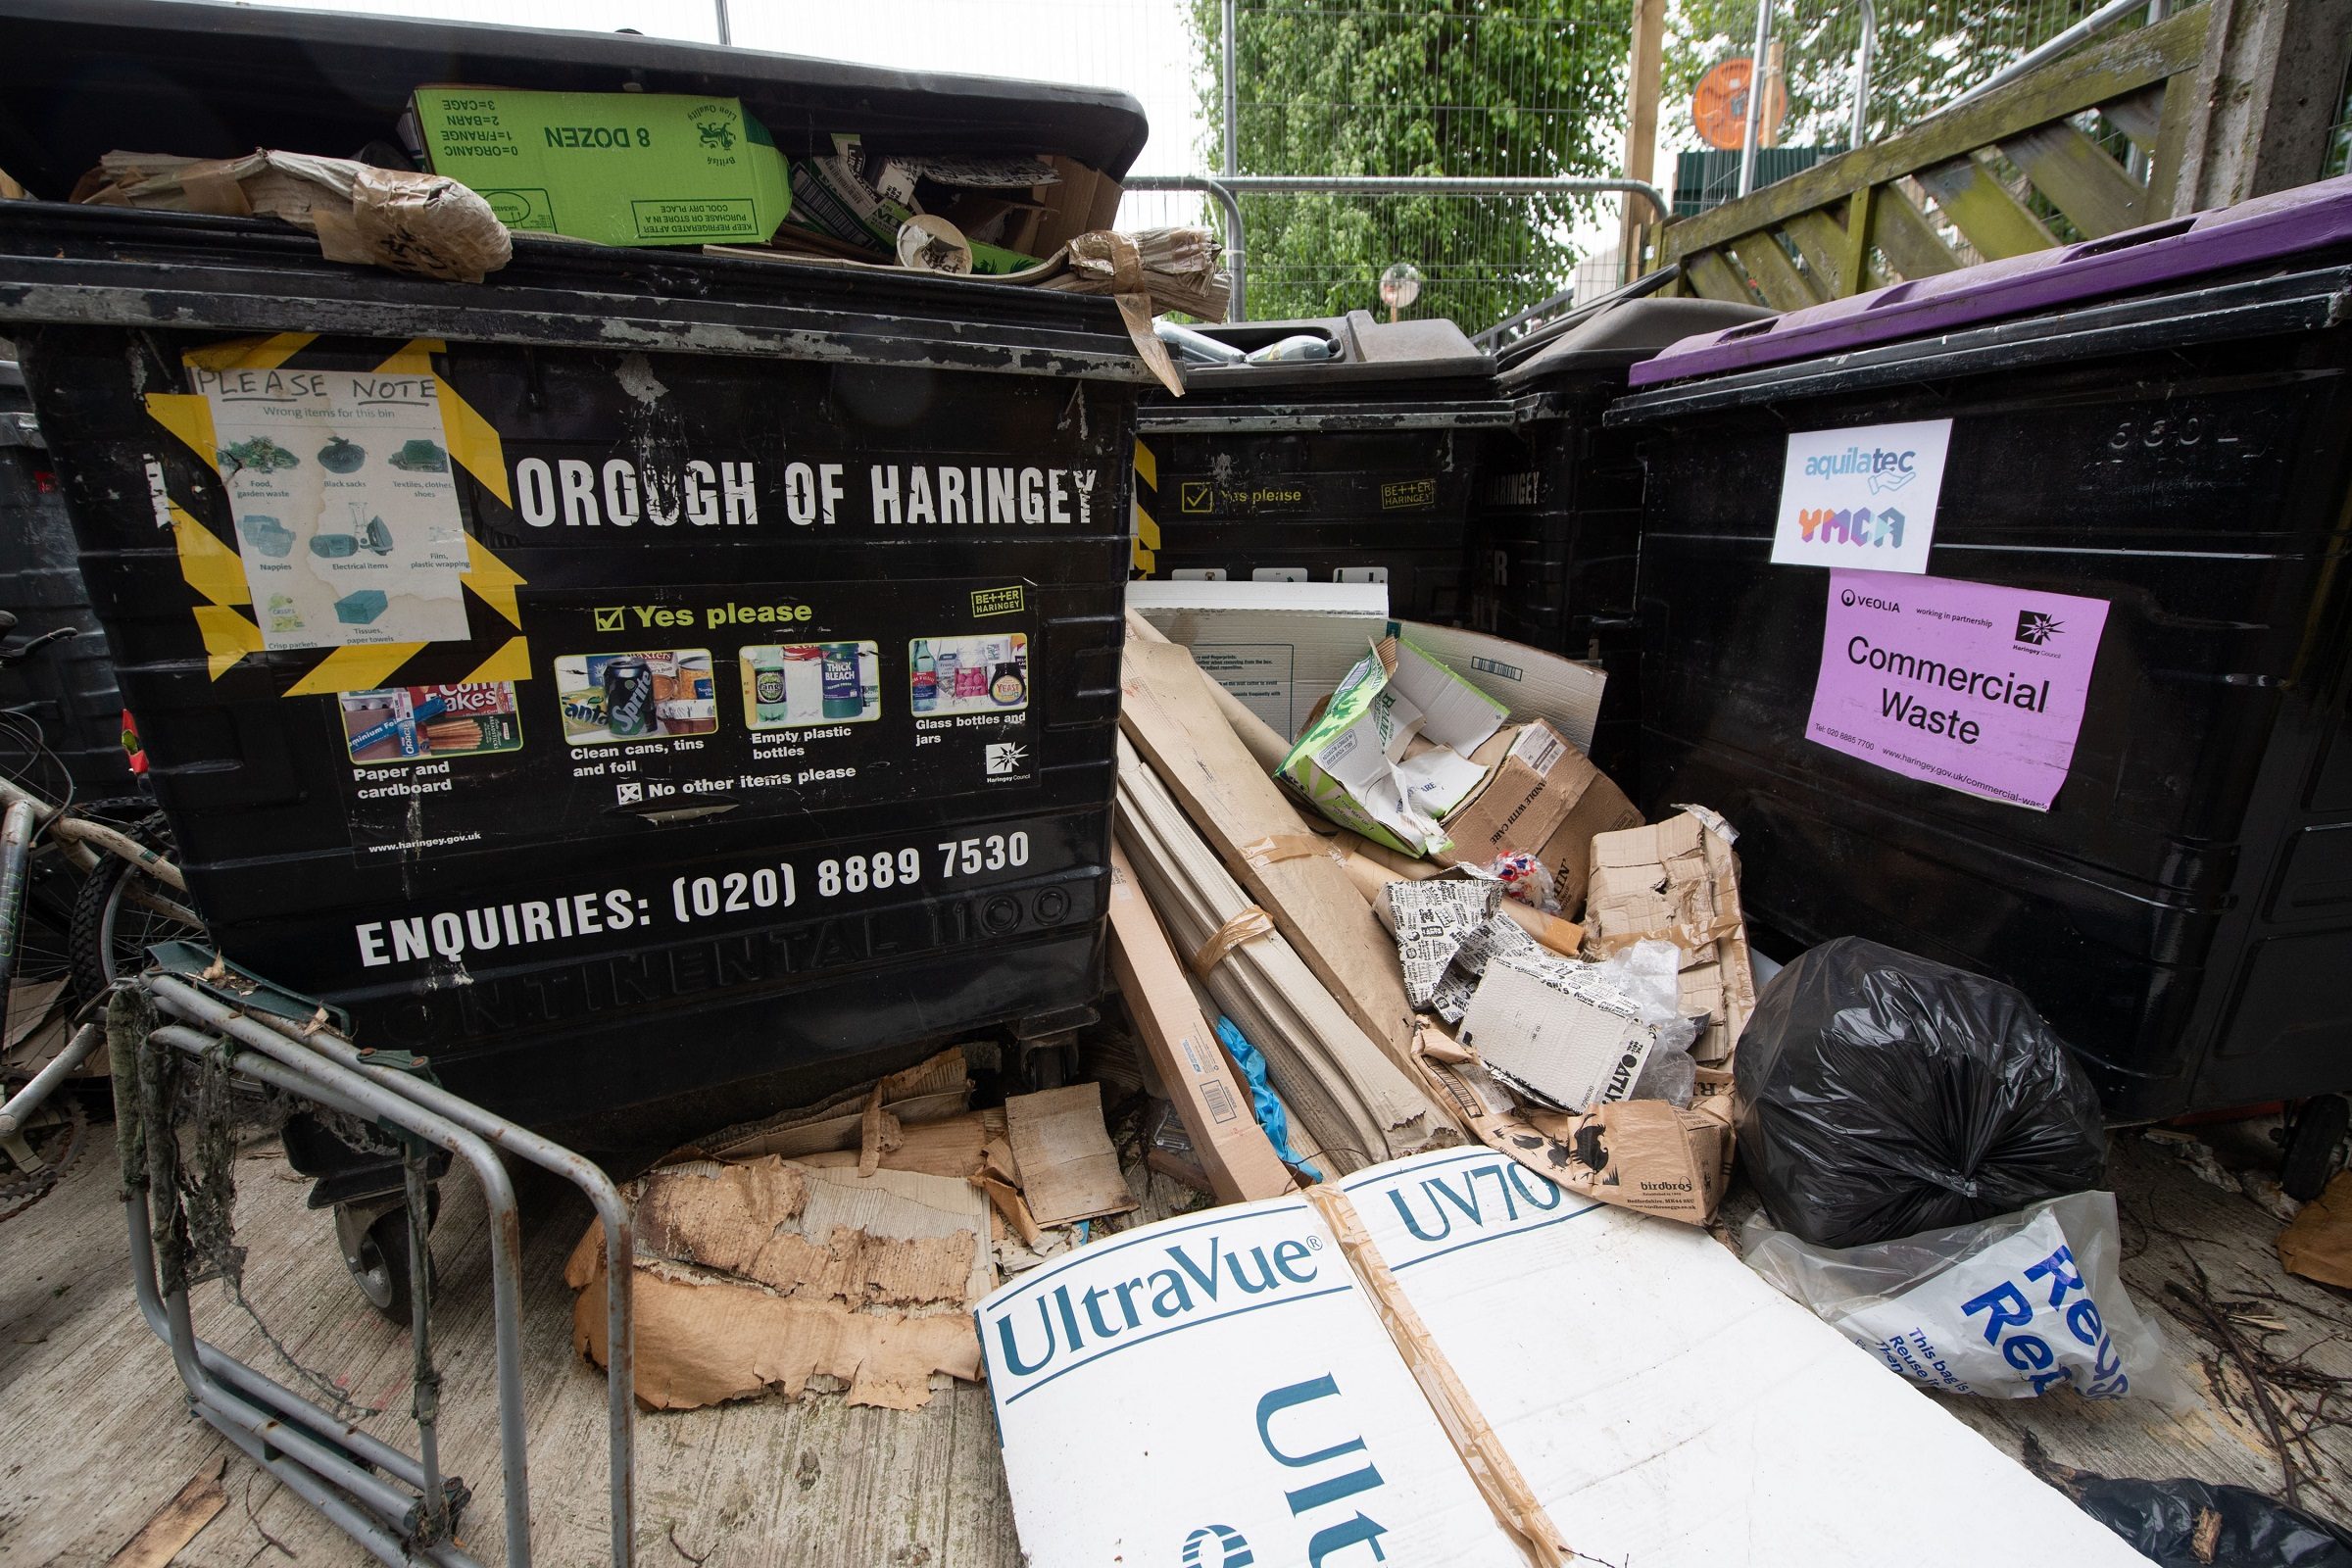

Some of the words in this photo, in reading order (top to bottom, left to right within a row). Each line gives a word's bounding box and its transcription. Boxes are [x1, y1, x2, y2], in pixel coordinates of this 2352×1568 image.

[442, 100, 496, 111] 3=CAGE
[688, 105, 716, 122] Quality
[720, 106, 737, 122] Lion
[447, 116, 500, 126] 2=BARN
[441, 130, 513, 141] 1=F/RANGE
[544, 125, 631, 149] DOZEN
[637, 126, 651, 147] 8
[444, 146, 518, 157] 0=ORGANIC
[708, 156, 736, 167] British
[709, 204, 728, 213] COOL
[671, 223, 730, 232] REFRIGERATED
[197, 369, 327, 397] PLEASE
[353, 378, 437, 400] NOTE
[263, 407, 304, 419] Wrong
[305, 407, 335, 417] items
[337, 408, 354, 418] for
[355, 408, 375, 418] this
[376, 408, 395, 418] bin
[1805, 446, 1916, 480] aquilatec
[250, 479, 272, 489] Food,
[424, 481, 455, 490] clothes,
[516, 456, 760, 528] OROUGH
[784, 462, 845, 525] OF
[870, 465, 1097, 525] HARINGEY
[236, 490, 264, 500] garden
[1252, 488, 1302, 504] please
[1384, 492, 1433, 506] HARINGEY
[1798, 506, 1905, 549] YMCA
[411, 561, 434, 570] plastic
[435, 561, 470, 569] wrapping
[976, 601, 1020, 613] HARINGEY
[1858, 595, 1901, 613] VEOLIA
[634, 605, 694, 628] Yes
[708, 602, 813, 629] please
[1916, 607, 1943, 619] working
[1943, 611, 1951, 619] in
[1951, 612, 1993, 628] partnership
[347, 636, 368, 646] paper
[368, 635, 394, 644] towels
[354, 627, 383, 636] Tissues,
[269, 642, 286, 651] Crisp
[287, 641, 318, 650] packets
[2012, 644, 2041, 656] Haringey
[2040, 650, 2062, 659] Council
[825, 670, 856, 681] BLEACH
[826, 662, 853, 672] THICK
[1846, 634, 2051, 714] Commercial
[996, 683, 1019, 692] YEAST
[612, 670, 653, 732] Sprite
[915, 718, 953, 731] Glass
[956, 714, 1001, 728] bottles
[1004, 711, 1026, 724] and
[1880, 686, 1981, 746] Waste
[488, 716, 499, 751] BREADSTICKS
[751, 730, 800, 745] Empty
[804, 725, 853, 742] plastic
[915, 734, 942, 747] jars
[1815, 723, 1827, 733] Tel:
[1826, 726, 1839, 738] 020
[1839, 731, 1857, 745] 8885
[1857, 737, 1875, 751] 7700
[570, 747, 619, 760] Clean
[624, 742, 669, 756] cans,
[673, 739, 705, 752] tins
[753, 746, 806, 760] bottles
[353, 767, 410, 783] Paper
[415, 760, 451, 776] and
[573, 763, 605, 777] and
[610, 760, 637, 774] foil
[357, 778, 453, 800] cardboard
[648, 784, 676, 799] No
[682, 777, 735, 795] other
[740, 774, 792, 789] items
[797, 766, 857, 785] please
[1530, 778, 1546, 804] ANDLE
[1351, 809, 1363, 820] WAY
[1507, 801, 1530, 826] WITH
[368, 832, 482, 854] www.haringey.gov.uk
[1489, 822, 1510, 845] CARE
[355, 888, 651, 968] ENQUIRIES:
[672, 862, 797, 923] (020)
[817, 848, 921, 897] 8889
[937, 830, 1030, 879] 7530
[1641, 1179, 1692, 1193] birdbros
[1385, 1170, 1561, 1242] UV70
[2022, 1244, 2132, 1400] Reus
[1875, 1341, 1904, 1374] Then
[1888, 1335, 1929, 1379] Reuse
[1927, 1378, 1940, 1388] it
[1908, 1326, 1936, 1360] This
[1933, 1359, 1960, 1385] bag
[1955, 1381, 1969, 1393] is
[1255, 1371, 1390, 1568] Ult
